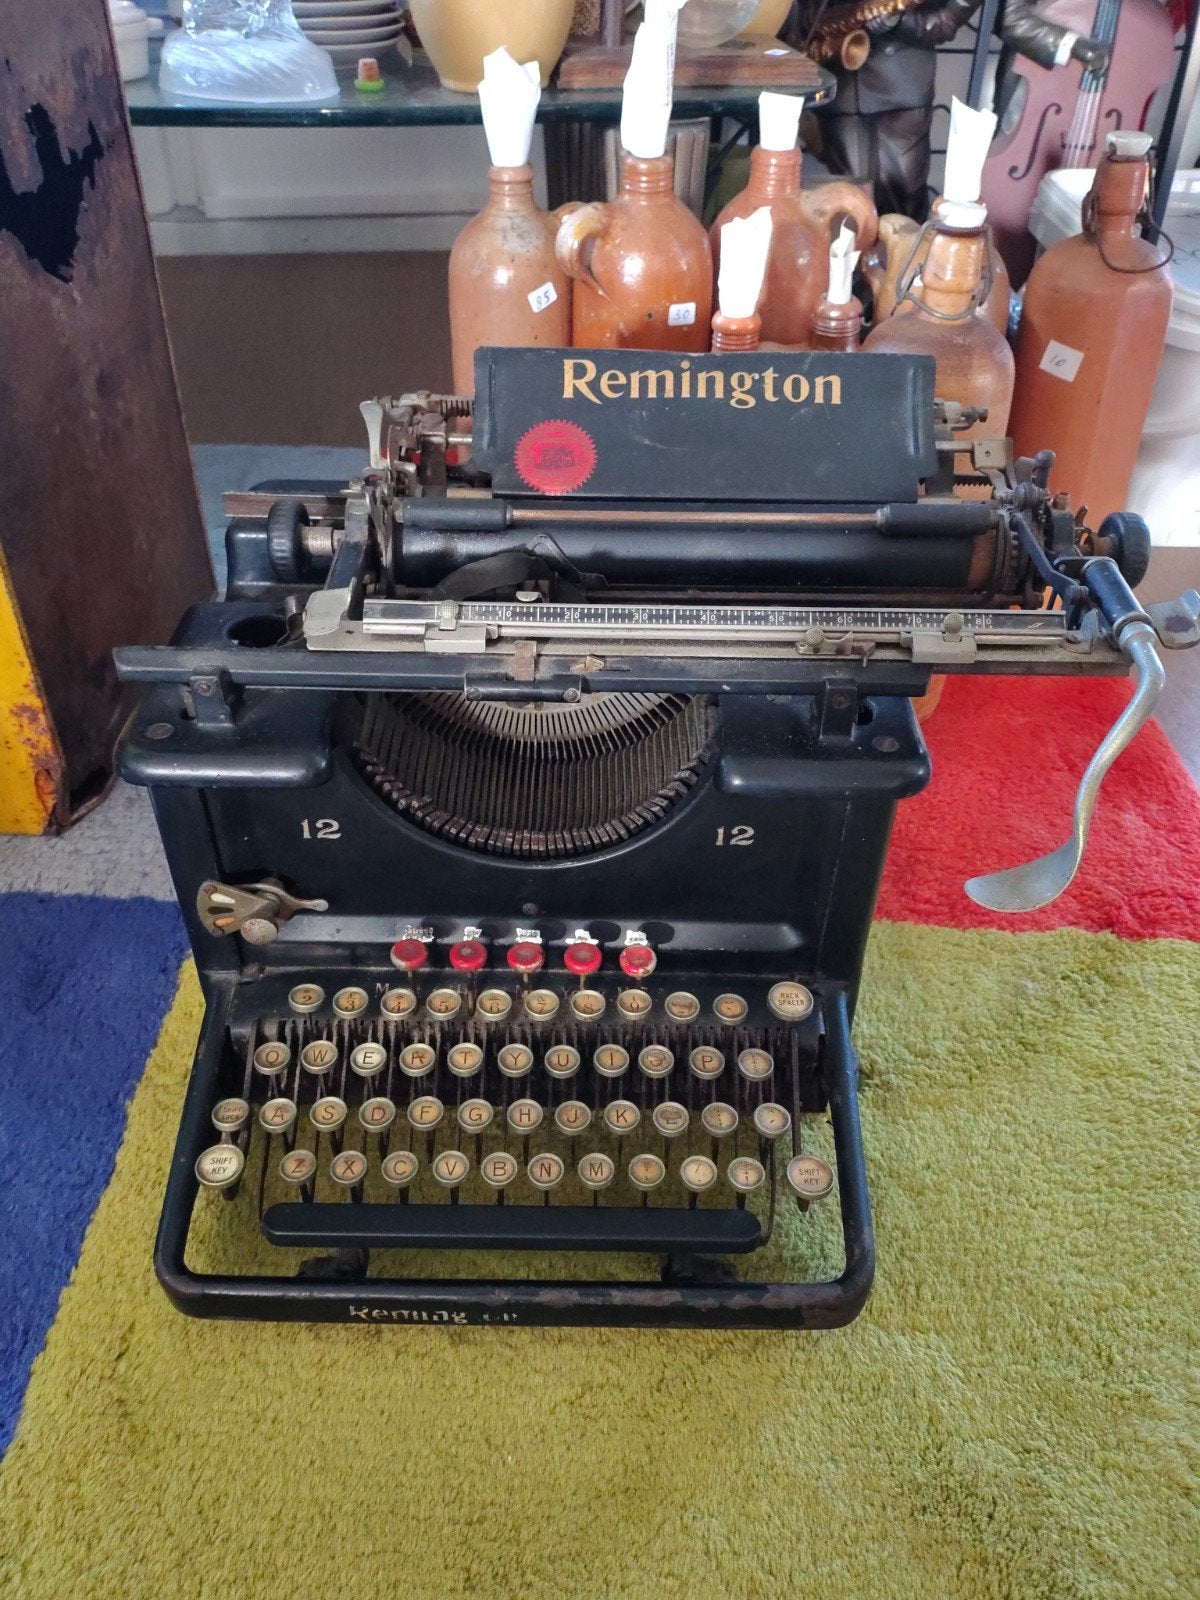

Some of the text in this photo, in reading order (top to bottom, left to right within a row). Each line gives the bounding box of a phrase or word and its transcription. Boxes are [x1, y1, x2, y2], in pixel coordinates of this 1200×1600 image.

[535, 290, 551, 310] 85
[562, 358, 842, 409] Remington
[300, 818, 342, 839] 12
[715, 825, 755, 846] 12
[777, 999, 806, 1007] SPACER
[265, 1050, 280, 1065] Q
[312, 1049, 328, 1063] W
[362, 1051, 375, 1065] E
[458, 1051, 472, 1064] T
[509, 1052, 522, 1066] Y
[557, 1053, 569, 1067] U
[701, 1055, 713, 1068] P
[270, 1105, 284, 1121] A
[321, 1105, 336, 1120] S
[371, 1107, 386, 1121] D
[420, 1105, 432, 1120] F
[468, 1107, 482, 1121] G
[519, 1108, 531, 1122] H
[566, 1109, 578, 1124] J
[616, 1108, 628, 1124] K
[210, 1157, 233, 1165] SHIFT
[341, 1160, 355, 1175] X
[393, 1160, 407, 1176] C
[445, 1160, 458, 1176] V
[493, 1161, 507, 1177] B
[539, 1162, 552, 1178] N
[589, 1161, 604, 1177] M
[211, 1166, 228, 1175] KEY
[798, 1168, 821, 1176] SHIFT
[803, 1177, 819, 1185] KEY
